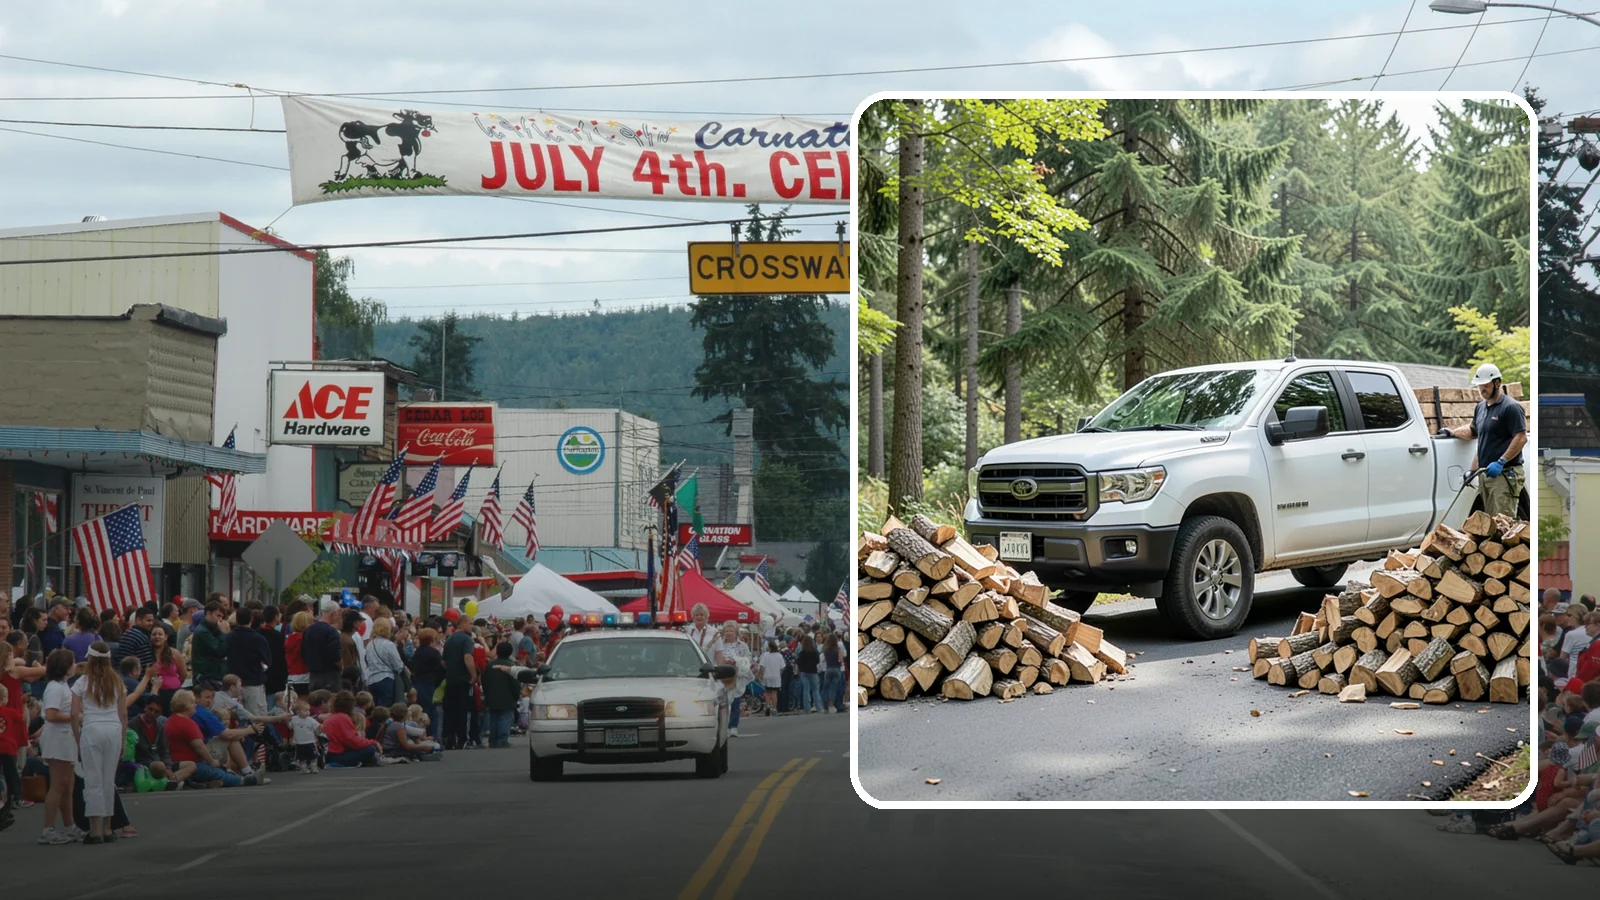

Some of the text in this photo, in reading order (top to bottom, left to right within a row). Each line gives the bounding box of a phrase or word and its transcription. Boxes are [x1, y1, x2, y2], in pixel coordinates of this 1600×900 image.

[481, 141, 605, 192] JULY
[632, 150, 746, 197] 4th.
[697, 254, 850, 280] CROSSWA
[282, 380, 374, 420] ACE
[405, 409, 485, 422] CEDAR LOG
[283, 421, 371, 436] Hardware
[416, 428, 477, 447] Coca-Cola
[353, 467, 384, 480] Simpl
[95, 485, 124, 494] Vincent
[126, 486, 135, 494] de
[138, 486, 155, 495] Paul
[80, 503, 154, 522] THT
[212, 516, 331, 535] HARDARE
[688, 526, 741, 535] CRNATION
[699, 535, 730, 543] GLASS
